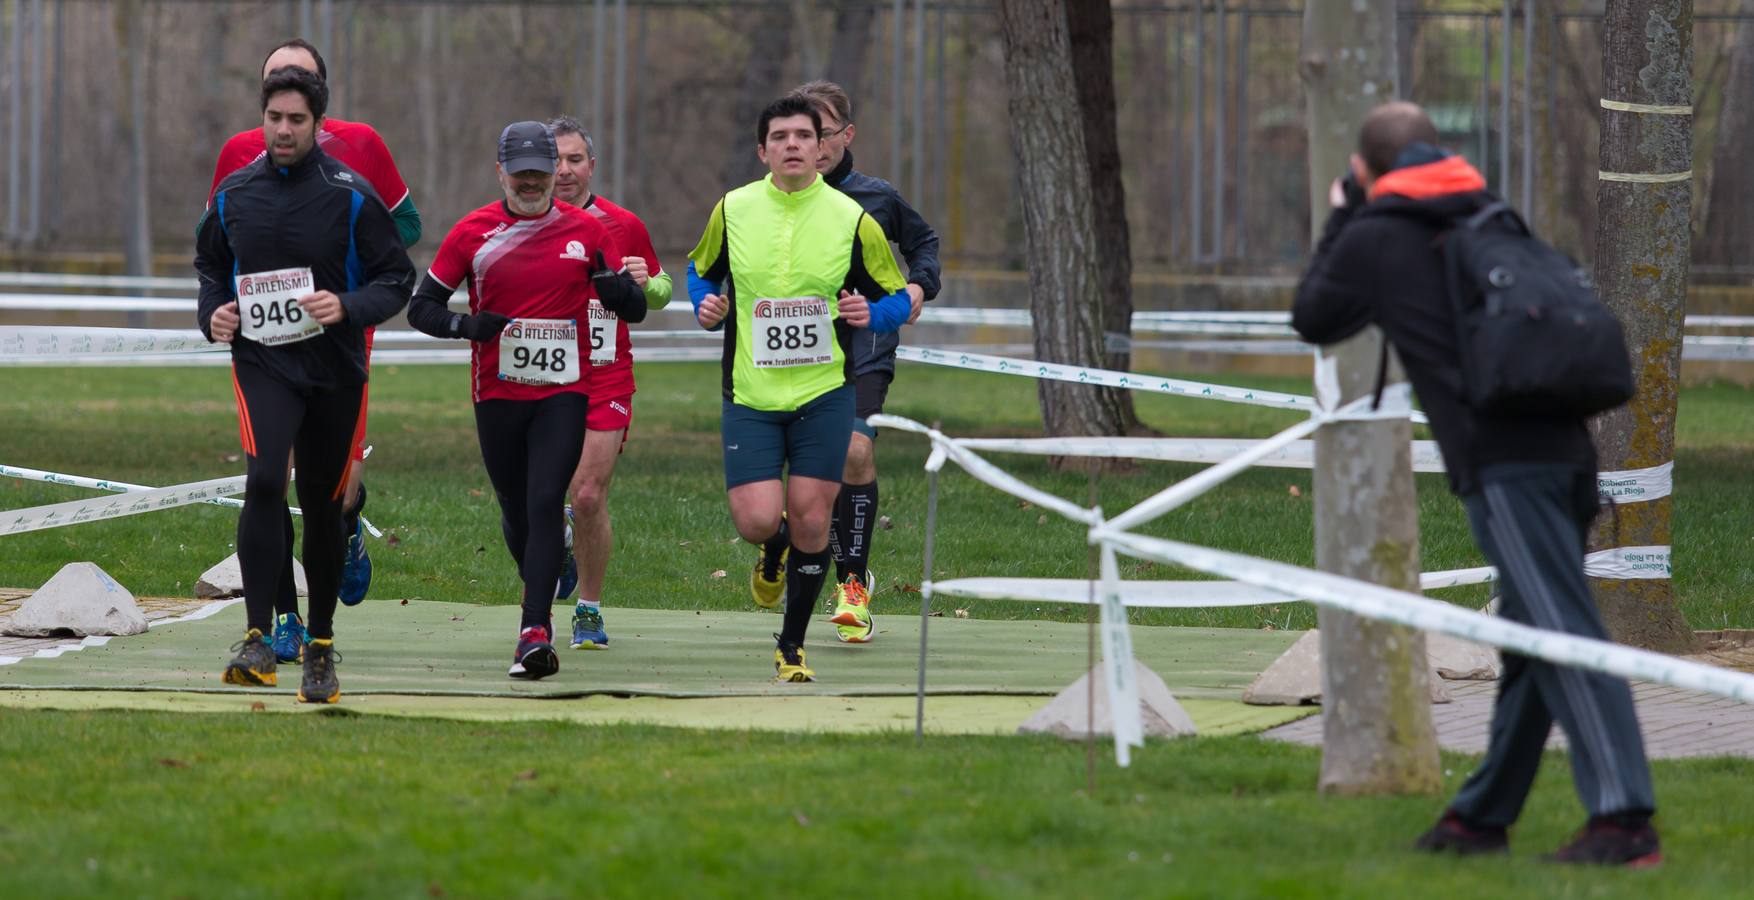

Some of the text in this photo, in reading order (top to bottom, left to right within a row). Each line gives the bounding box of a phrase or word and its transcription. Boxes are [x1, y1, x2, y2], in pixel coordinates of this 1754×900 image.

[255, 277, 309, 294] ATLETISMO
[250, 298, 302, 328] 946
[590, 308, 617, 320] TISMO
[774, 304, 829, 318] ATLETISMO
[525, 328, 576, 340] ATLETISMO
[591, 327, 604, 350] 5
[767, 324, 818, 350] 885
[513, 346, 566, 372] 948
[756, 355, 831, 366] www.fratletismo.com
[1599, 479, 1637, 487] Gobierno
[1612, 488, 1623, 496] La
[1625, 487, 1645, 496] Rioja
[1624, 553, 1644, 562] Rioja
[1632, 562, 1665, 570] Gobierno
